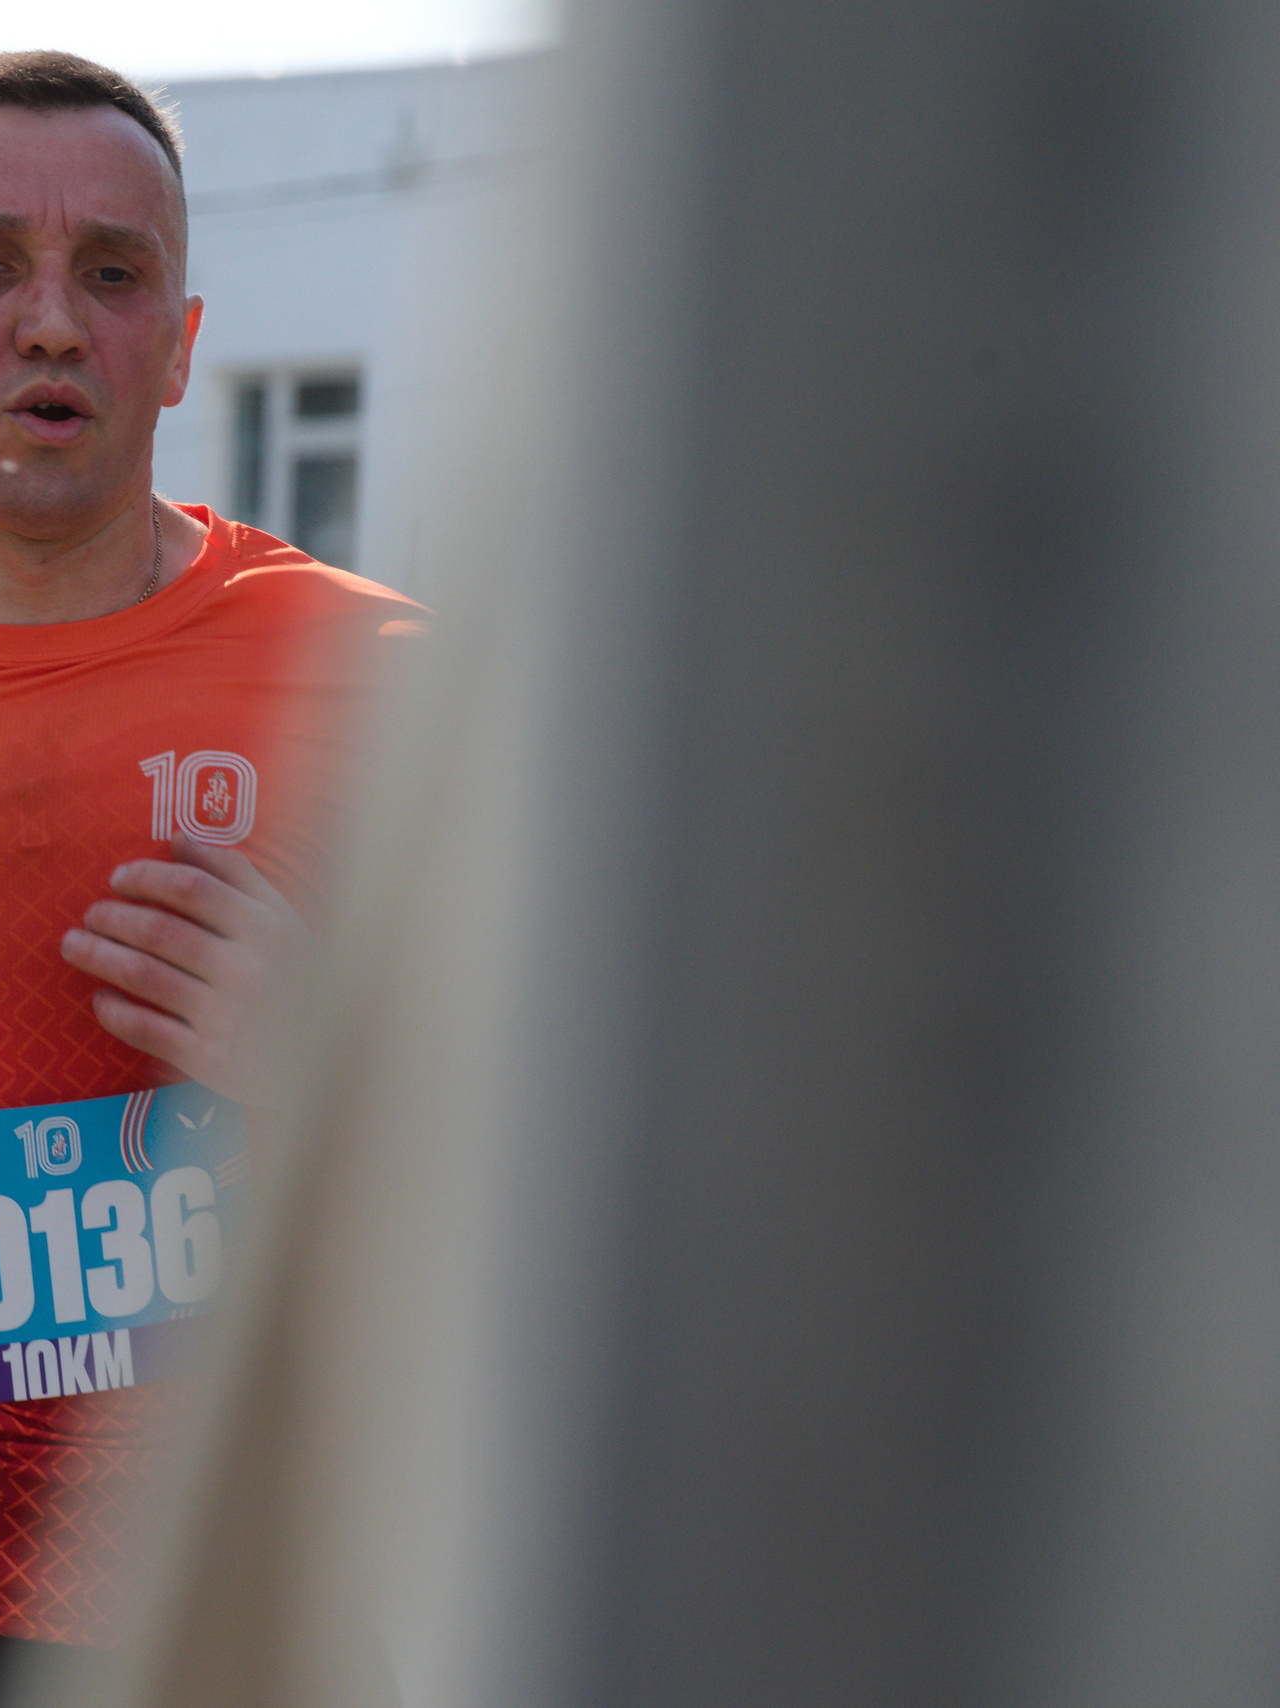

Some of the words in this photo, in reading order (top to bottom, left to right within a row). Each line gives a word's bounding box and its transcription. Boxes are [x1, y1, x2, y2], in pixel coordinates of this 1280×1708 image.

[138, 749, 258, 846] 10
[13, 1115, 83, 1179] 10
[2, 1328, 135, 1402] 10KM
